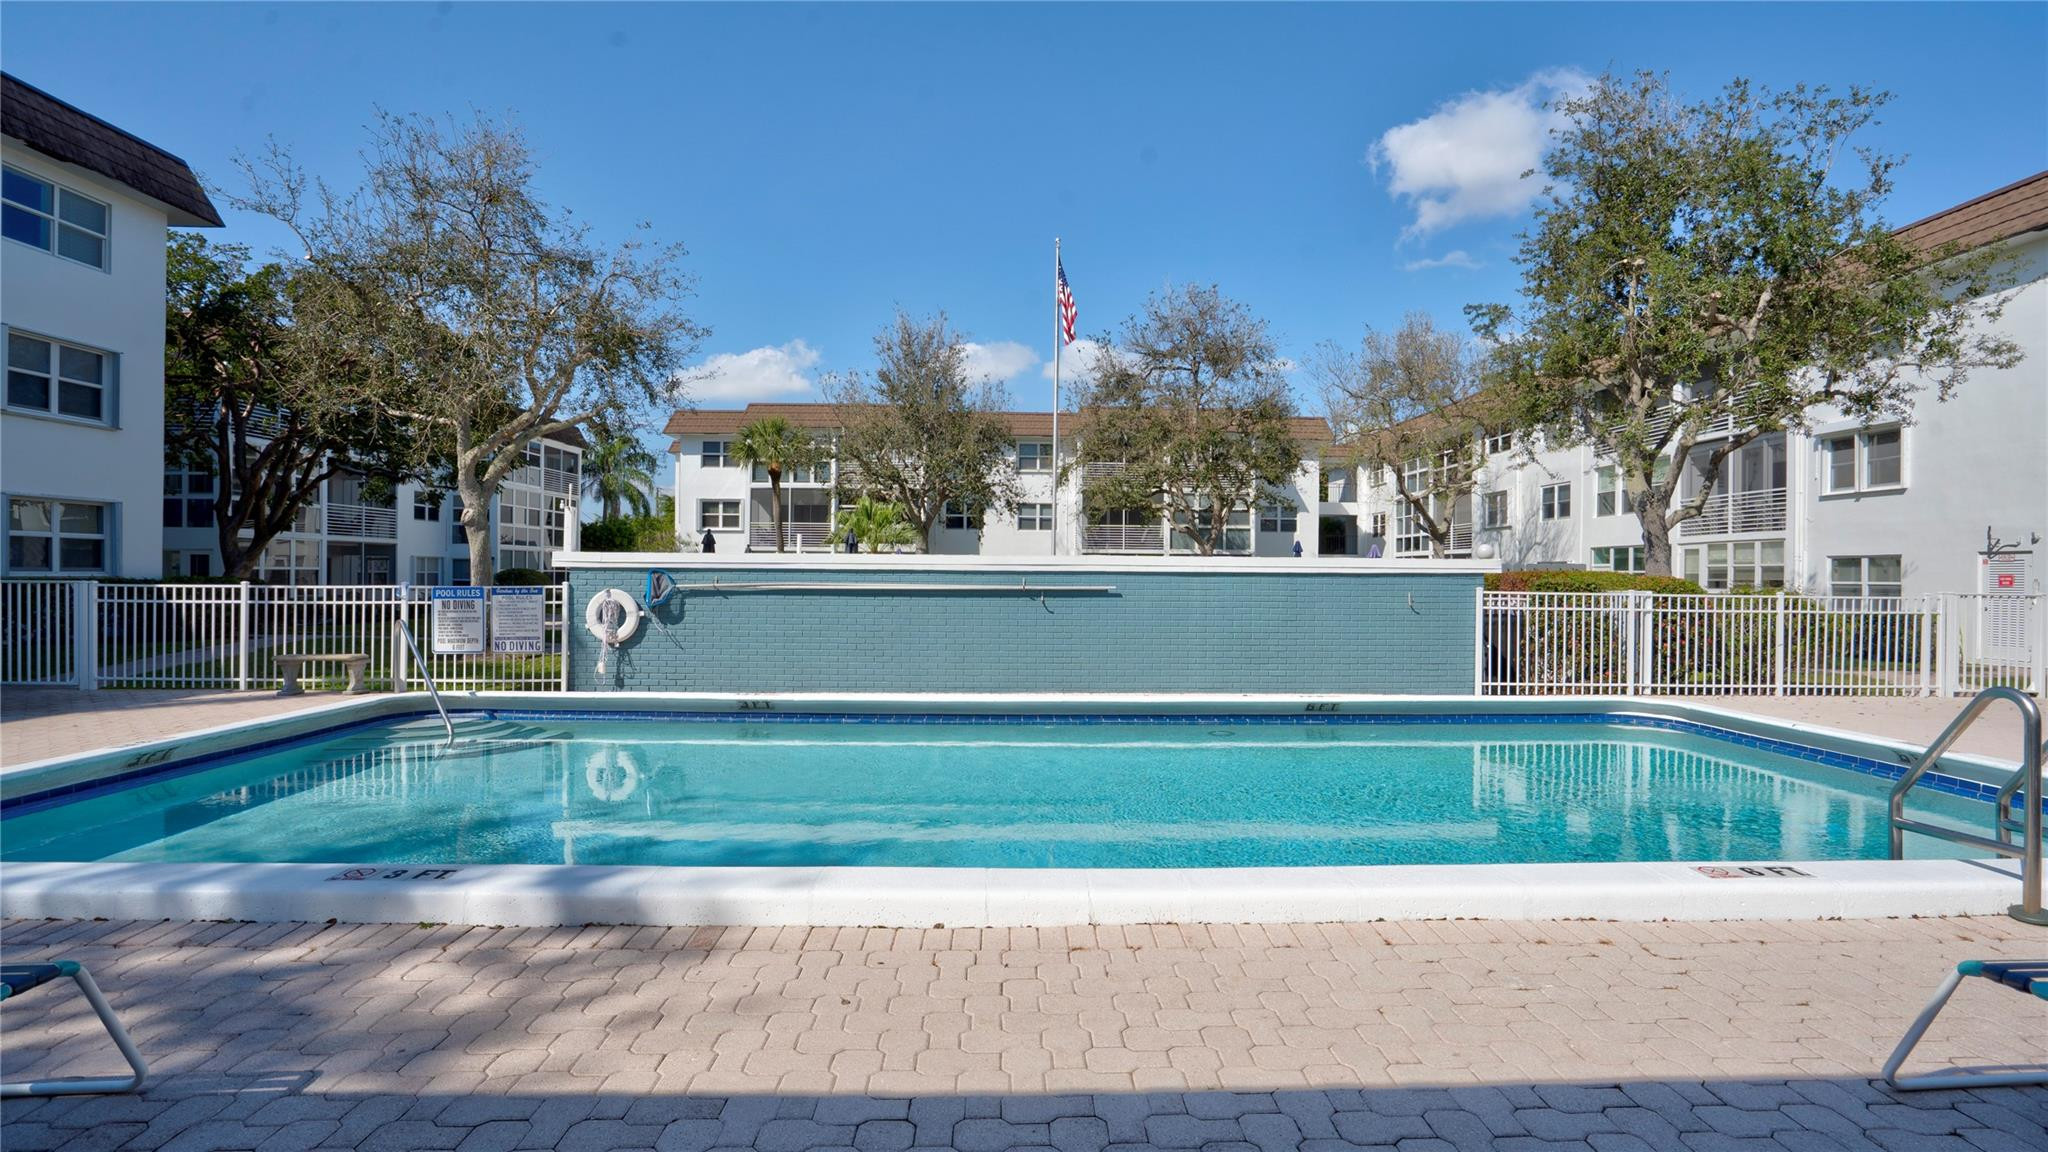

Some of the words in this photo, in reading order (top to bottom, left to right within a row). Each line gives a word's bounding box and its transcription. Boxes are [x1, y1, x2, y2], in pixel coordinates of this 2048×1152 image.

[457, 589, 481, 597] RULES
[441, 600, 451, 610] NO
[453, 600, 476, 610] DIVING
[494, 641, 507, 651] NO
[509, 641, 541, 651] DIVING
[383, 869, 408, 880] 3
[1738, 867, 1765, 877] 6
